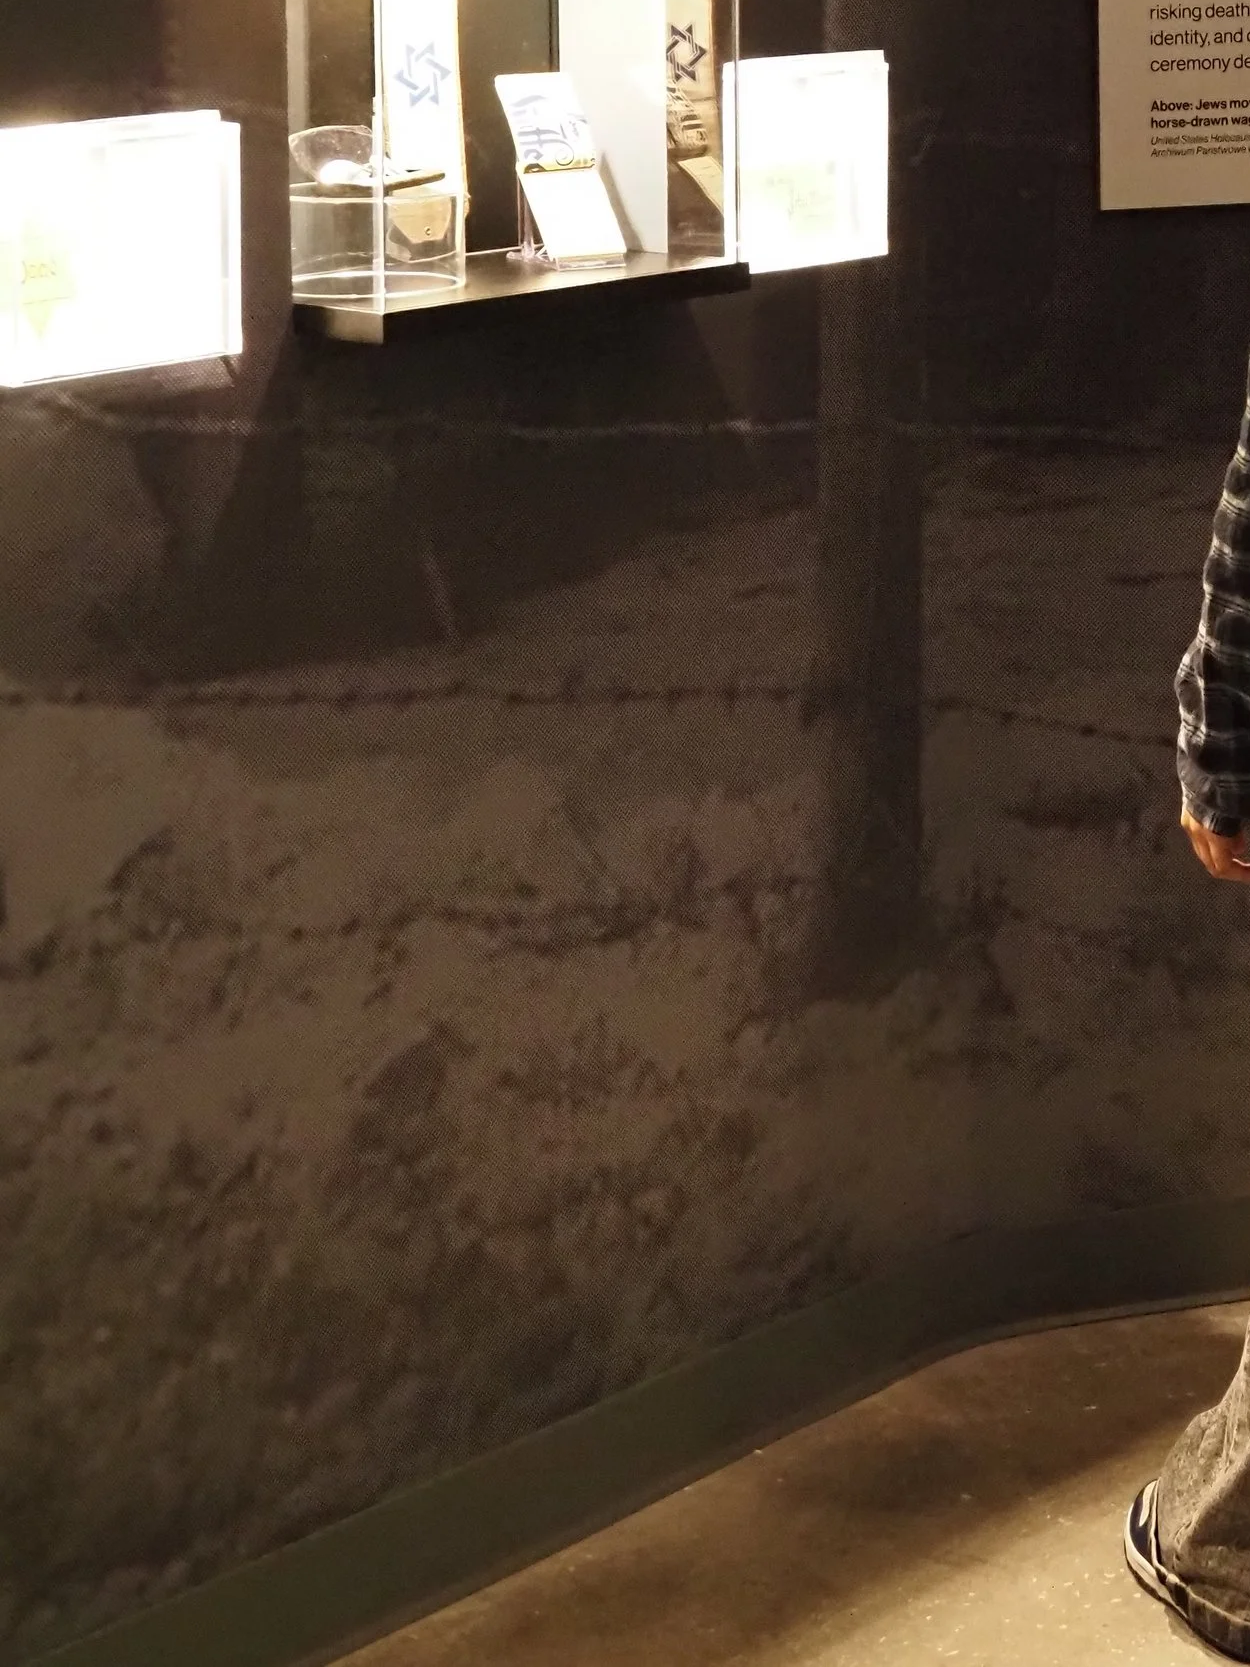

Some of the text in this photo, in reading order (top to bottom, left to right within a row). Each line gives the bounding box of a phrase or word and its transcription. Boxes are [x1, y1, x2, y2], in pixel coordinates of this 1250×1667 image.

[1150, 2, 1202, 22] risking
[1205, 2, 1250, 20] death
[1150, 29, 1211, 48] identity,
[1213, 26, 1244, 46] and
[1149, 56, 1231, 73] ceremony
[1150, 99, 1193, 112] Above:
[1195, 99, 1227, 110] Jews
[1150, 115, 1229, 130] horse-drawn
